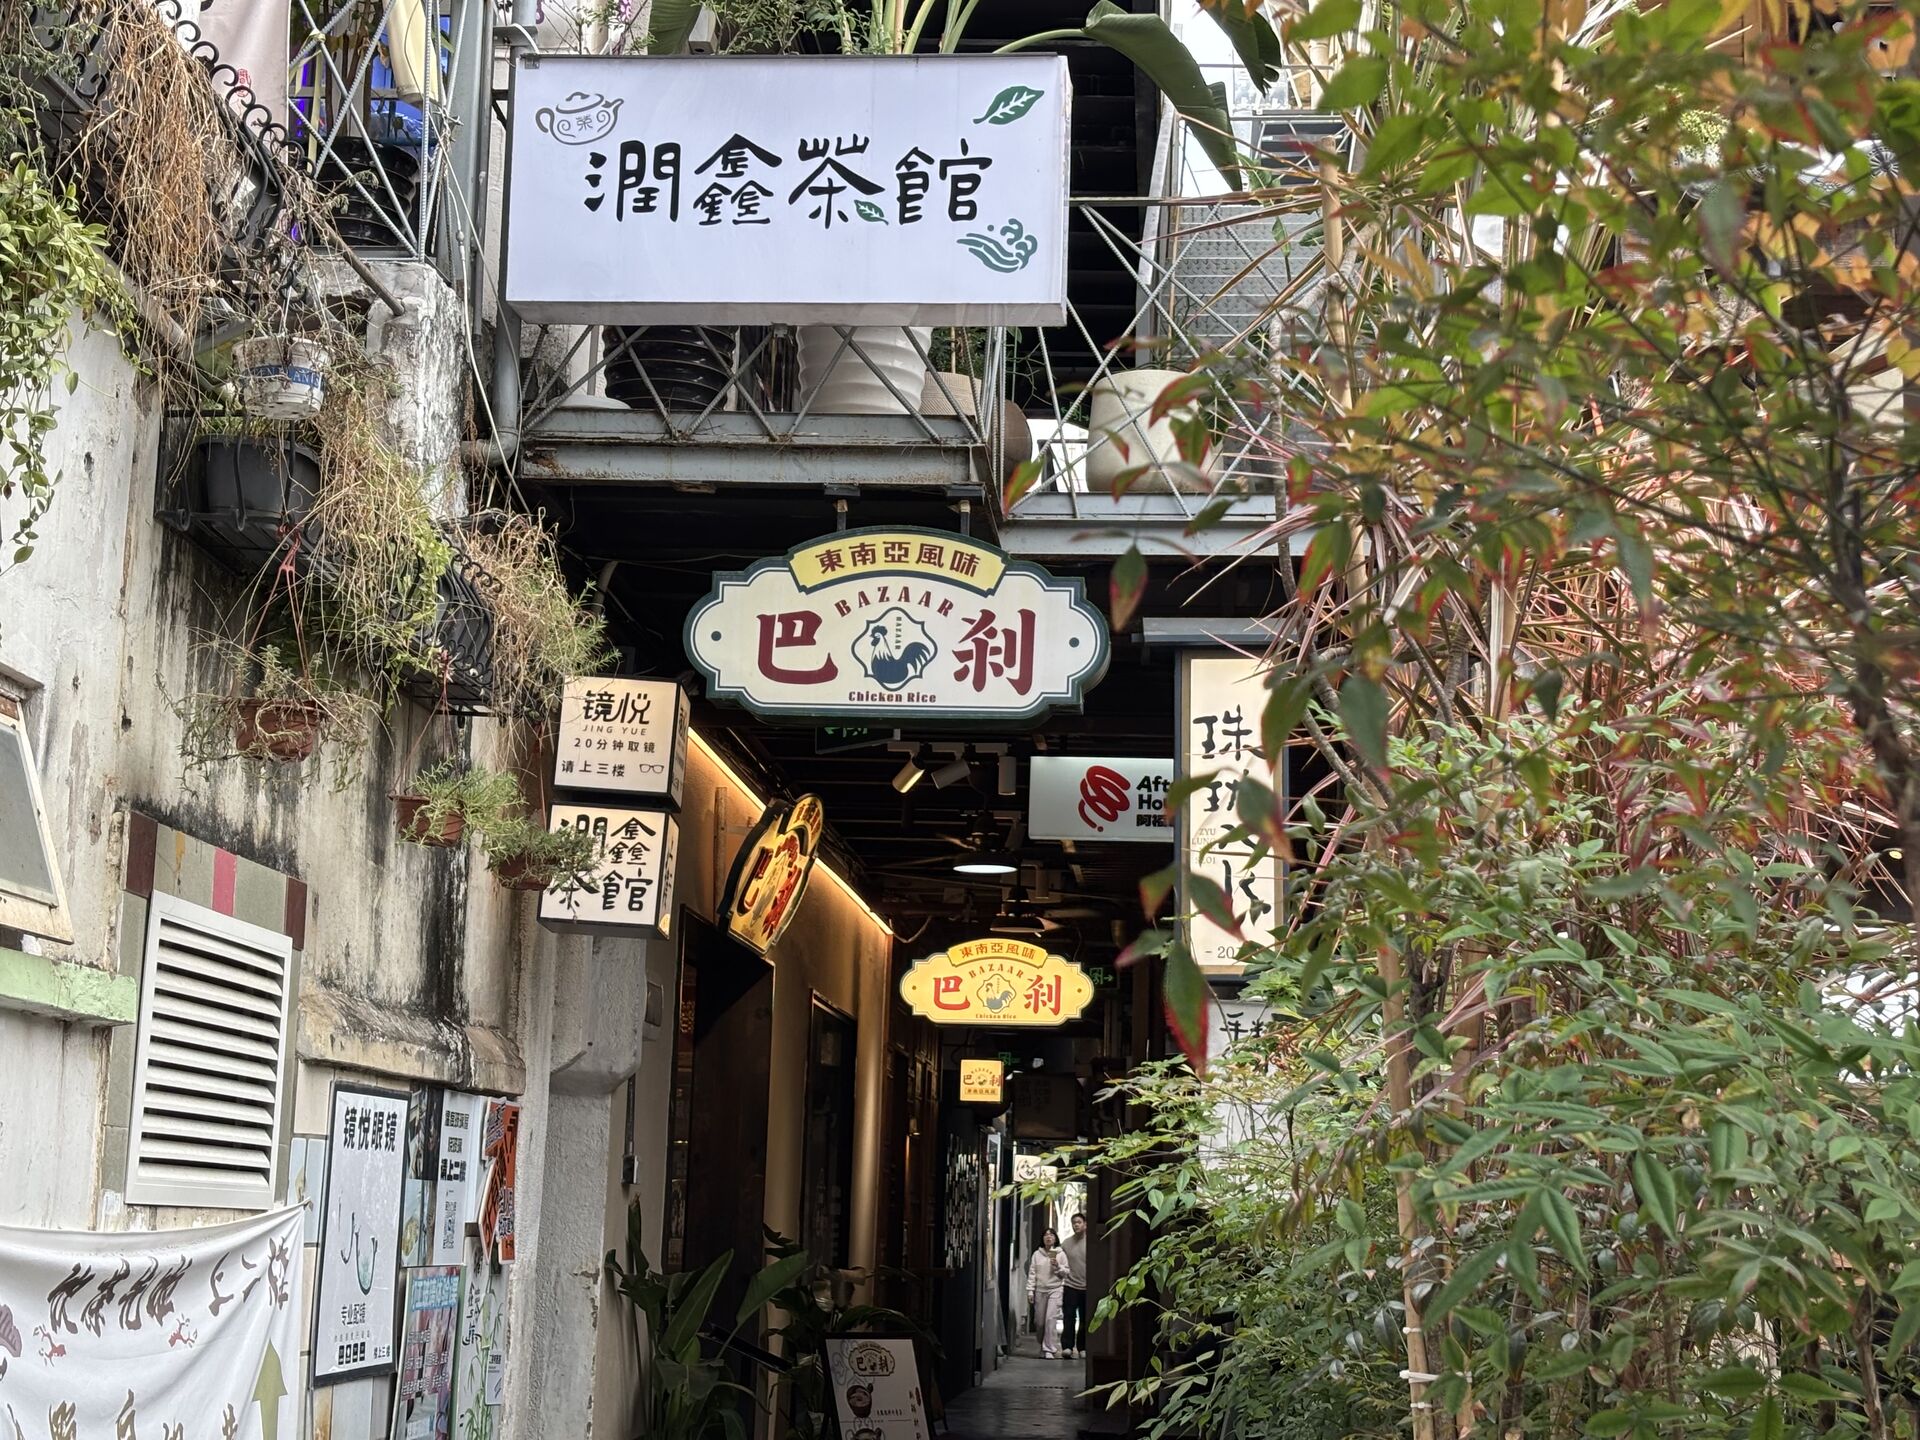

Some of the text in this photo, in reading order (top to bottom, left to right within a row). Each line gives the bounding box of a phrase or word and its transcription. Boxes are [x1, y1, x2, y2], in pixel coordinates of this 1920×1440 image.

[584, 133, 993, 227] 潤鑫茶館
[815, 540, 982, 578] 東南亞風味
[834, 586, 955, 618] BAZAAR
[848, 690, 937, 704] Chicken Rice
[582, 689, 651, 725] 镜悦
[582, 725, 648, 737] JING YUE
[573, 737, 656, 753] 20分钟取镜
[561, 759, 626, 778] 请上三楼
[1136, 775, 1173, 793] Aft
[960, 943, 1036, 960] 東南亞風味
[1217, 946, 1240, 959] 20
[968, 963, 1024, 979] BAZAAR
[342, 1105, 397, 1153] 镜悦眼镜
